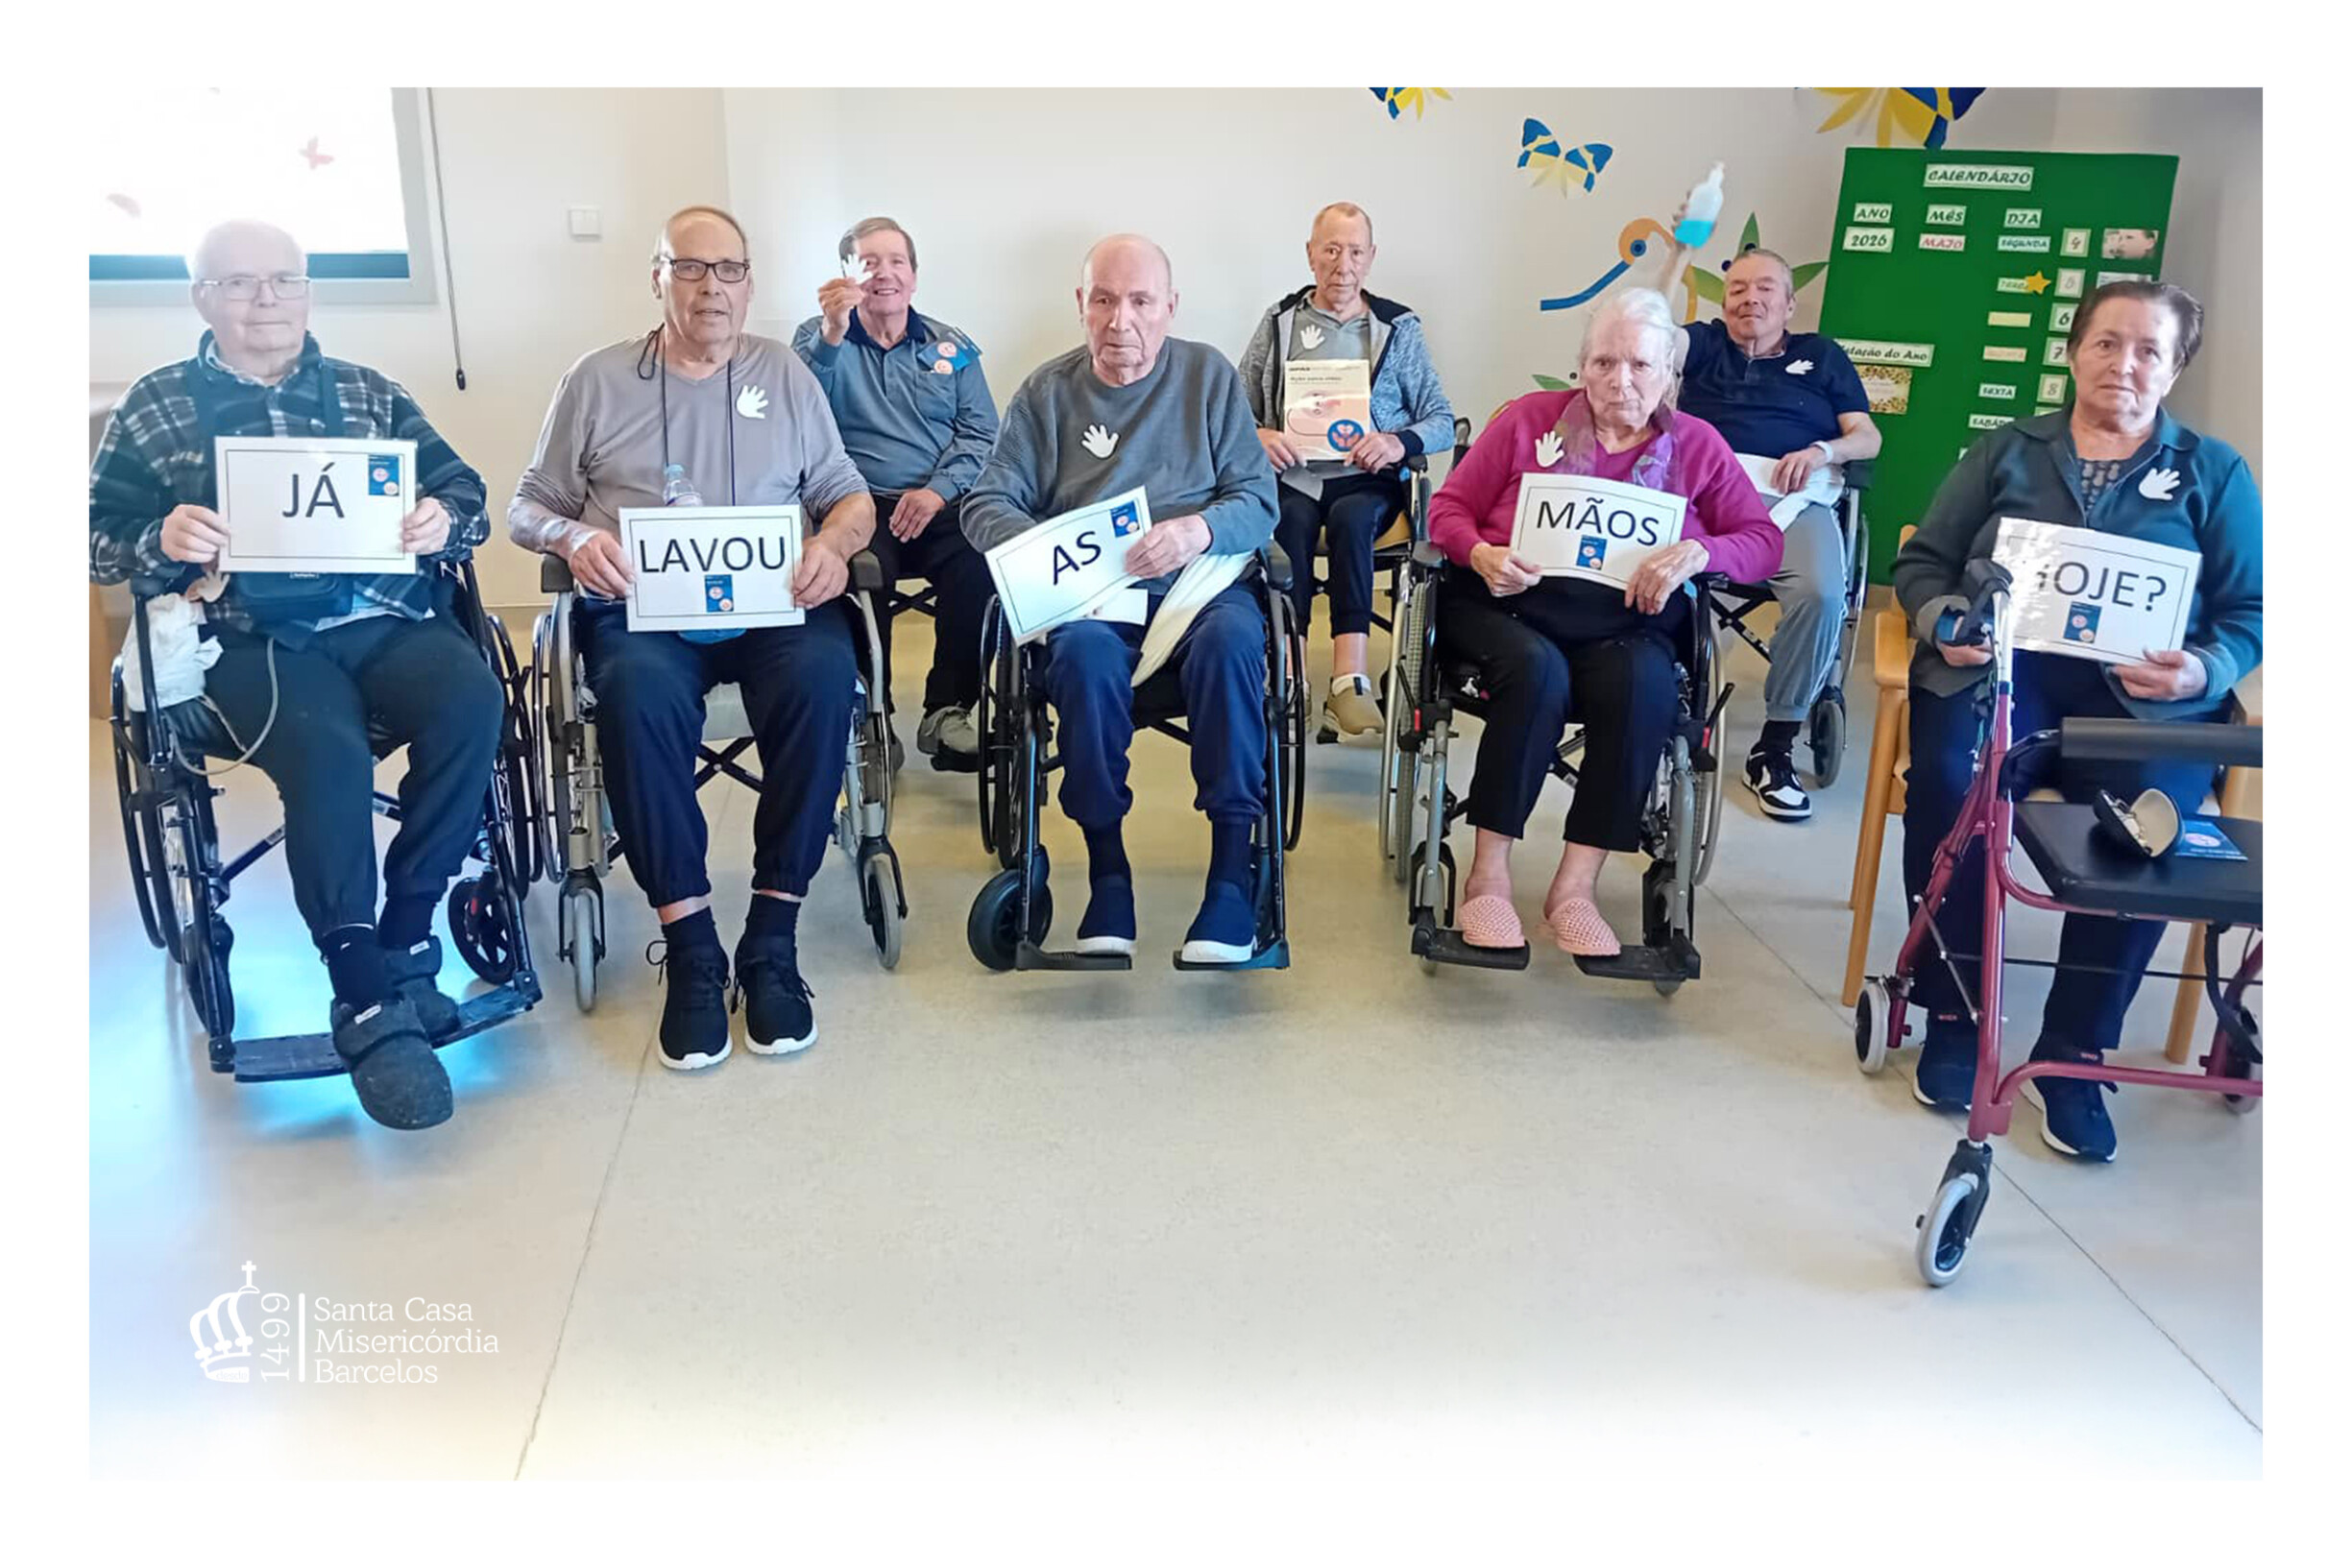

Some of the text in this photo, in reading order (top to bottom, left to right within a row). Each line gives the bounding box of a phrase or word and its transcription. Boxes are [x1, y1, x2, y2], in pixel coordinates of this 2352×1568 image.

[1928, 170, 2031, 184] CALENDÁRIO
[1856, 208, 1890, 220] ANO
[2006, 213, 2039, 225] DIA
[1851, 234, 1888, 247] 2026
[1922, 237, 1964, 250] MAIO
[2071, 236, 2082, 251] 4
[2058, 311, 2071, 326] 6
[1884, 348, 1901, 359] do
[1903, 350, 1928, 361] Ano
[2052, 346, 2064, 360] 7
[2047, 383, 2058, 397] 8
[282, 461, 346, 519] JÁ
[1537, 496, 1661, 547] MÃOS
[639, 535, 787, 573] LAVOU
[1053, 530, 1103, 587] AS
[2036, 560, 2169, 613] OJE?
